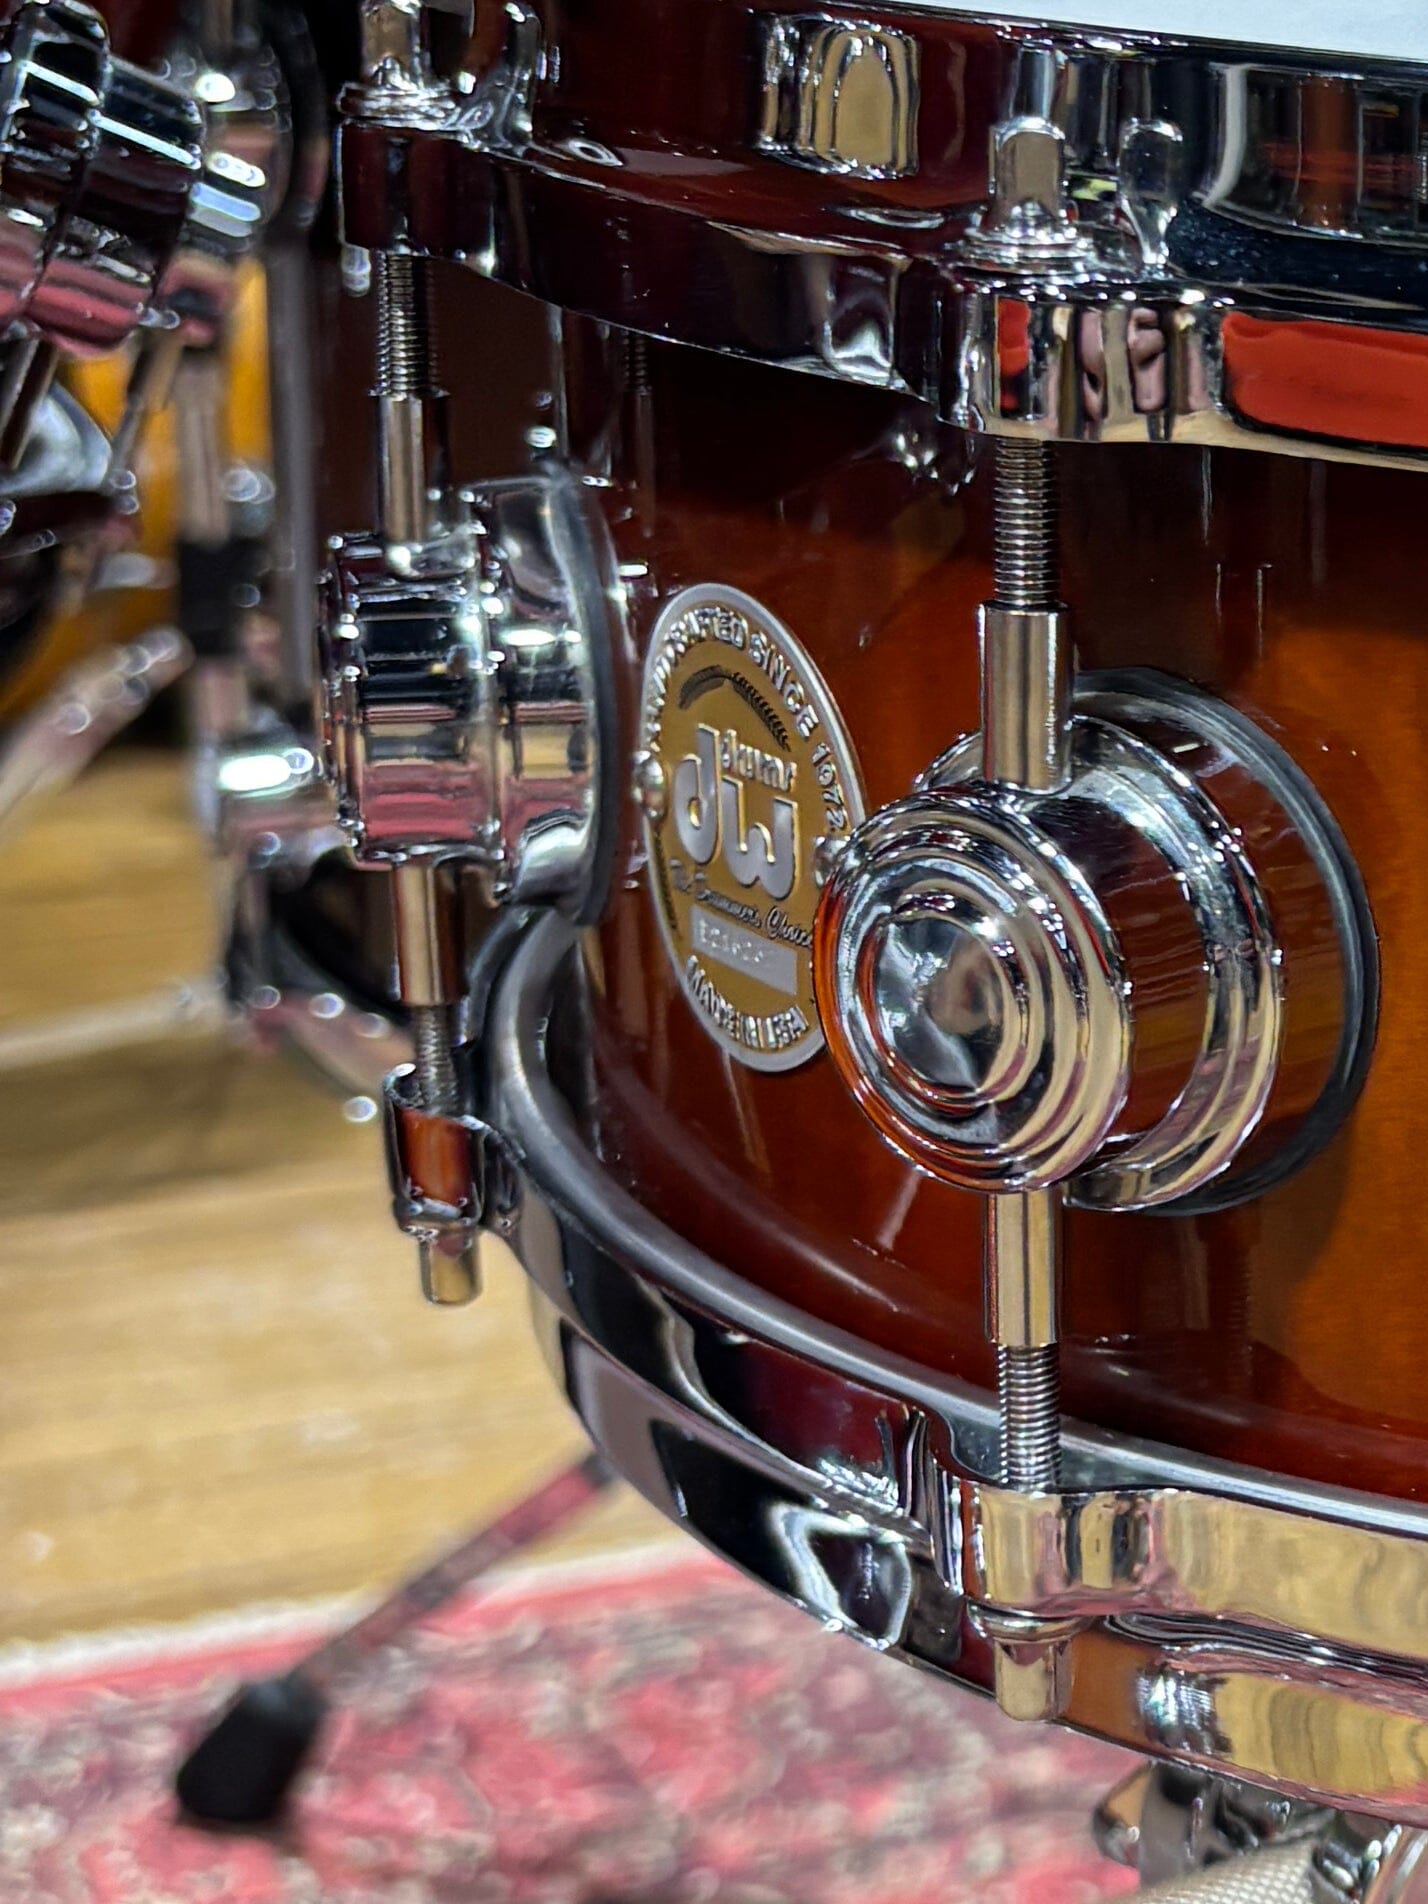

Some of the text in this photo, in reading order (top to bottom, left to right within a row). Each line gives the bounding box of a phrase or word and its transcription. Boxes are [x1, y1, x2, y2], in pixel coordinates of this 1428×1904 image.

[674, 722, 799, 899] dw
[749, 630, 820, 739] SINCE
[811, 742, 848, 829] 1972
